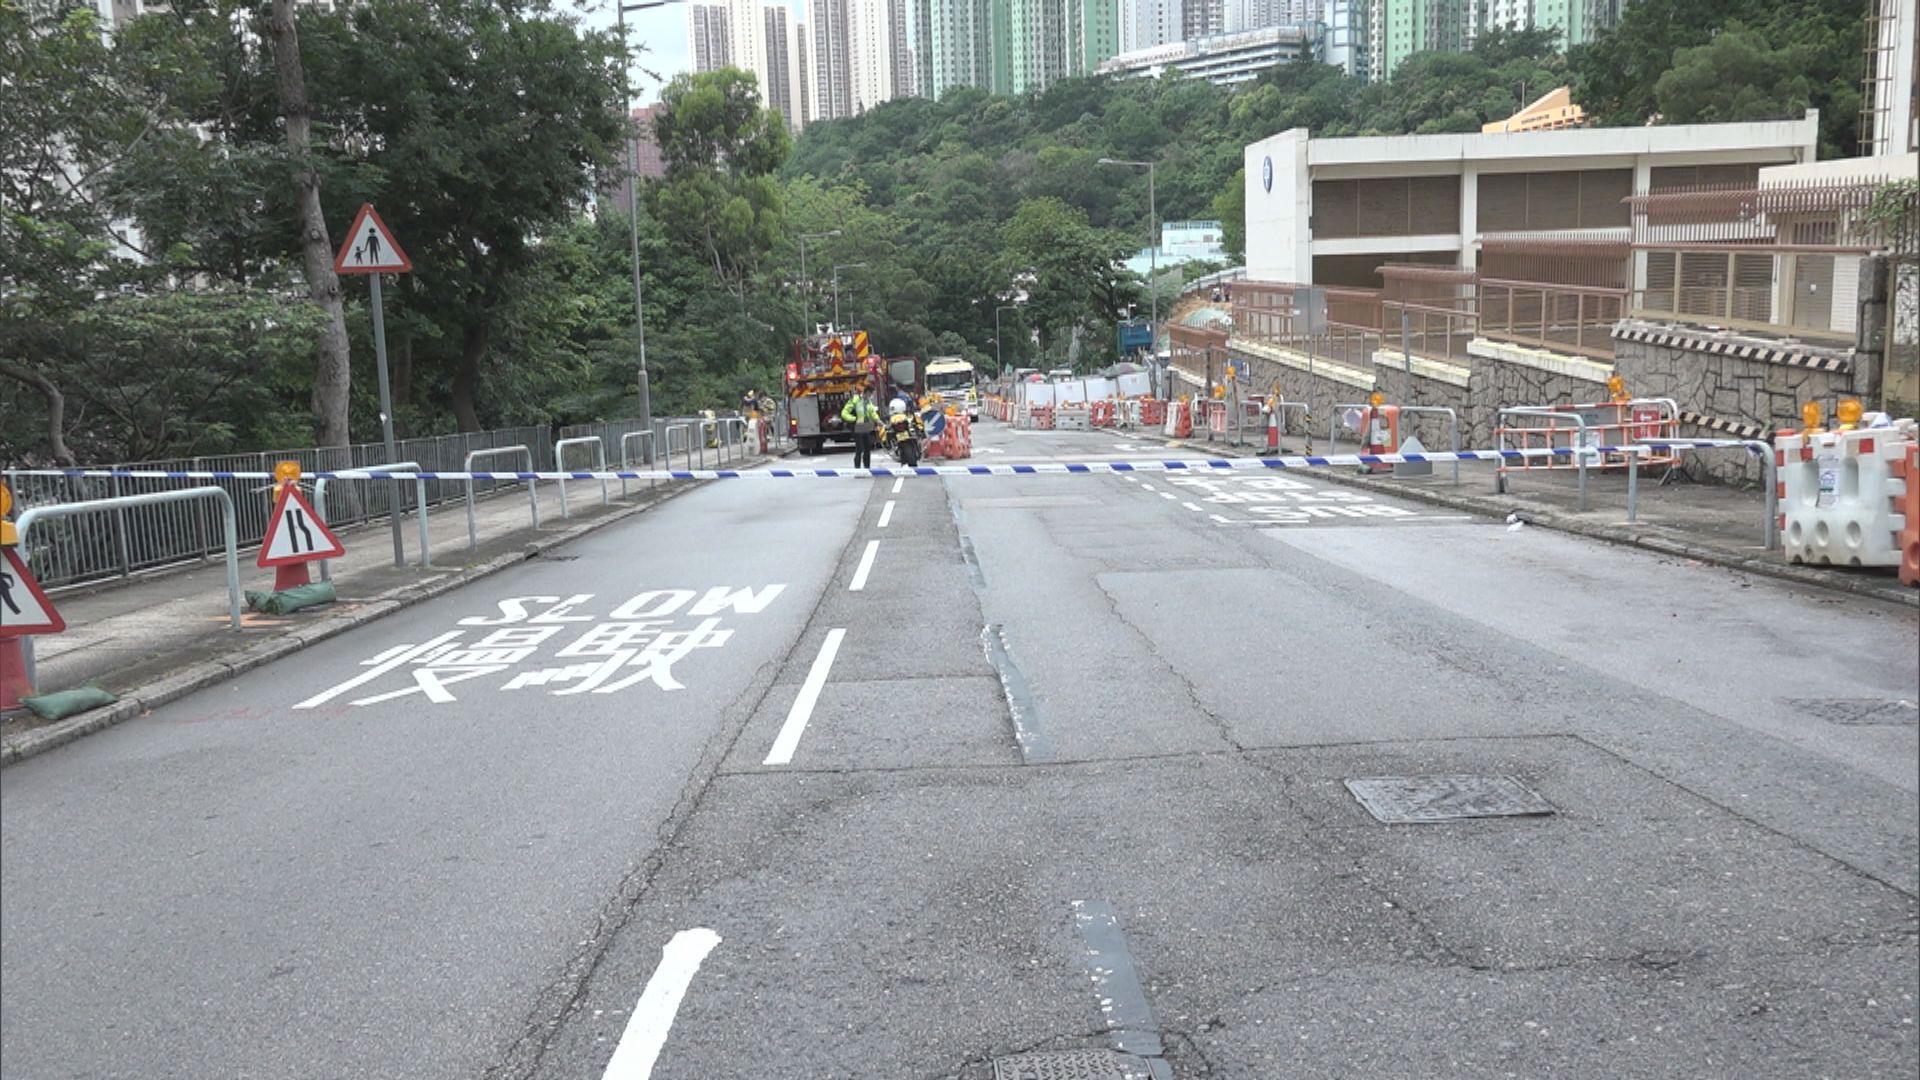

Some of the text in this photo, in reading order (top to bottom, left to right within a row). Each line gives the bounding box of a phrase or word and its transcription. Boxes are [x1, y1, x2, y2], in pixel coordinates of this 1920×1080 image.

[1202, 490, 1374, 503] STOP
[1248, 504, 1419, 519] BUS
[458, 584, 788, 625] SLOW
[291, 617, 735, 710] 慢駛
